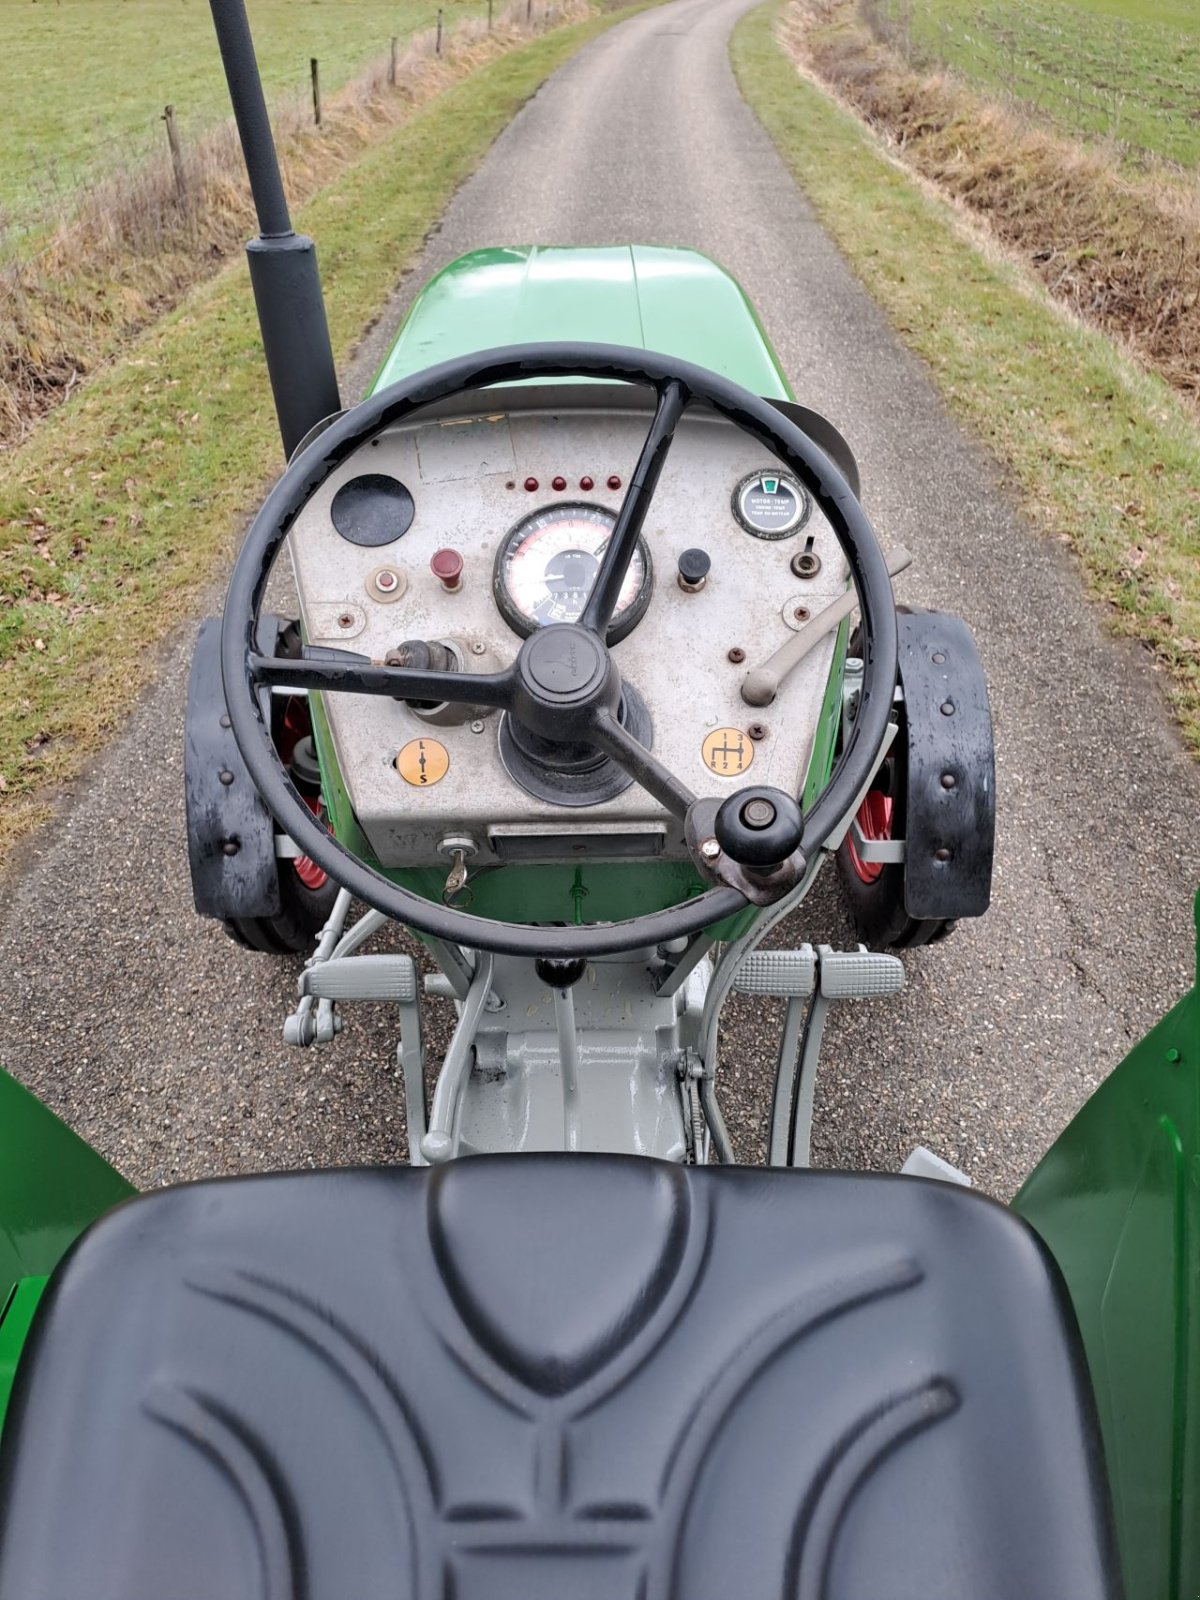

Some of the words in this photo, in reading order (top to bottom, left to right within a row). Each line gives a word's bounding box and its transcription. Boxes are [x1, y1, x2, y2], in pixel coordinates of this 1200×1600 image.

[737, 733, 744, 741] 3
[419, 740, 426, 750] L
[419, 774, 428, 784] S
